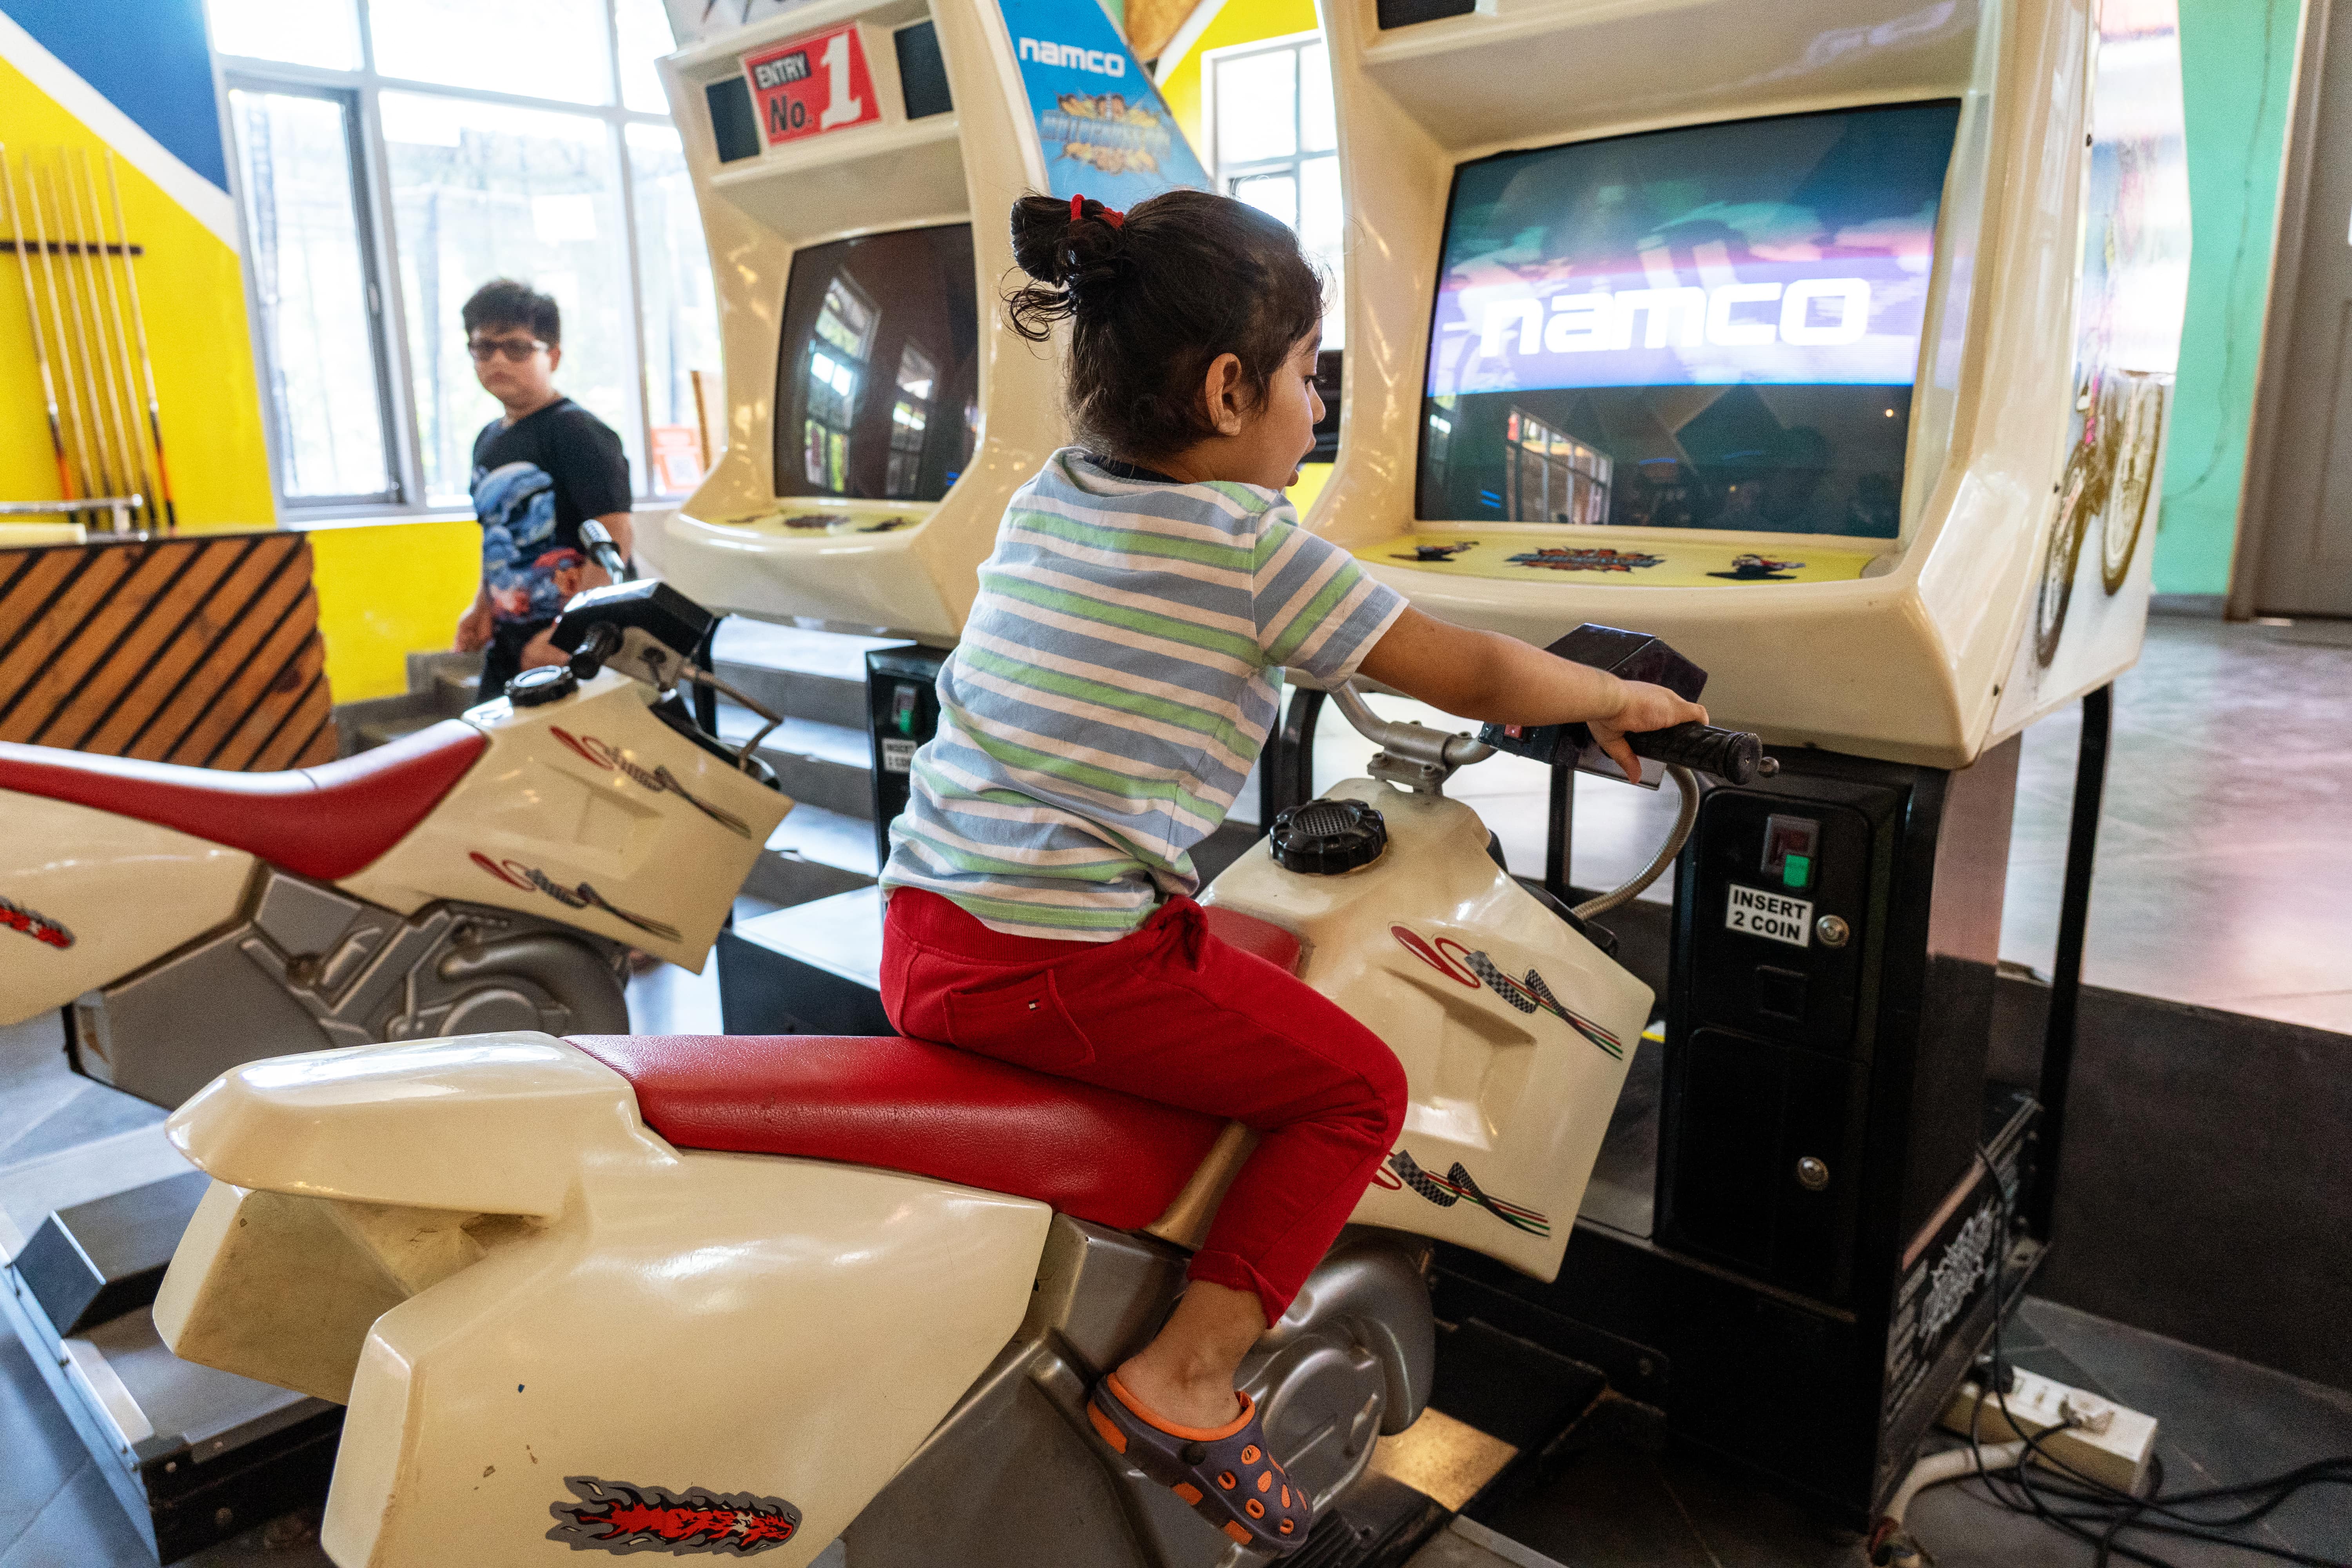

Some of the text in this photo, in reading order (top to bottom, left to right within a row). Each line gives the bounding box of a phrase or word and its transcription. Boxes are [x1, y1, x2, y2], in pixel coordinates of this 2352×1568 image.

[755, 53, 809, 89] ENTRY
[1019, 37, 1125, 78] namco
[769, 33, 862, 134] No. 1
[1479, 278, 1871, 358] namco
[1733, 889, 1806, 920] INSERT
[1734, 912, 1800, 940] 2 COIN
